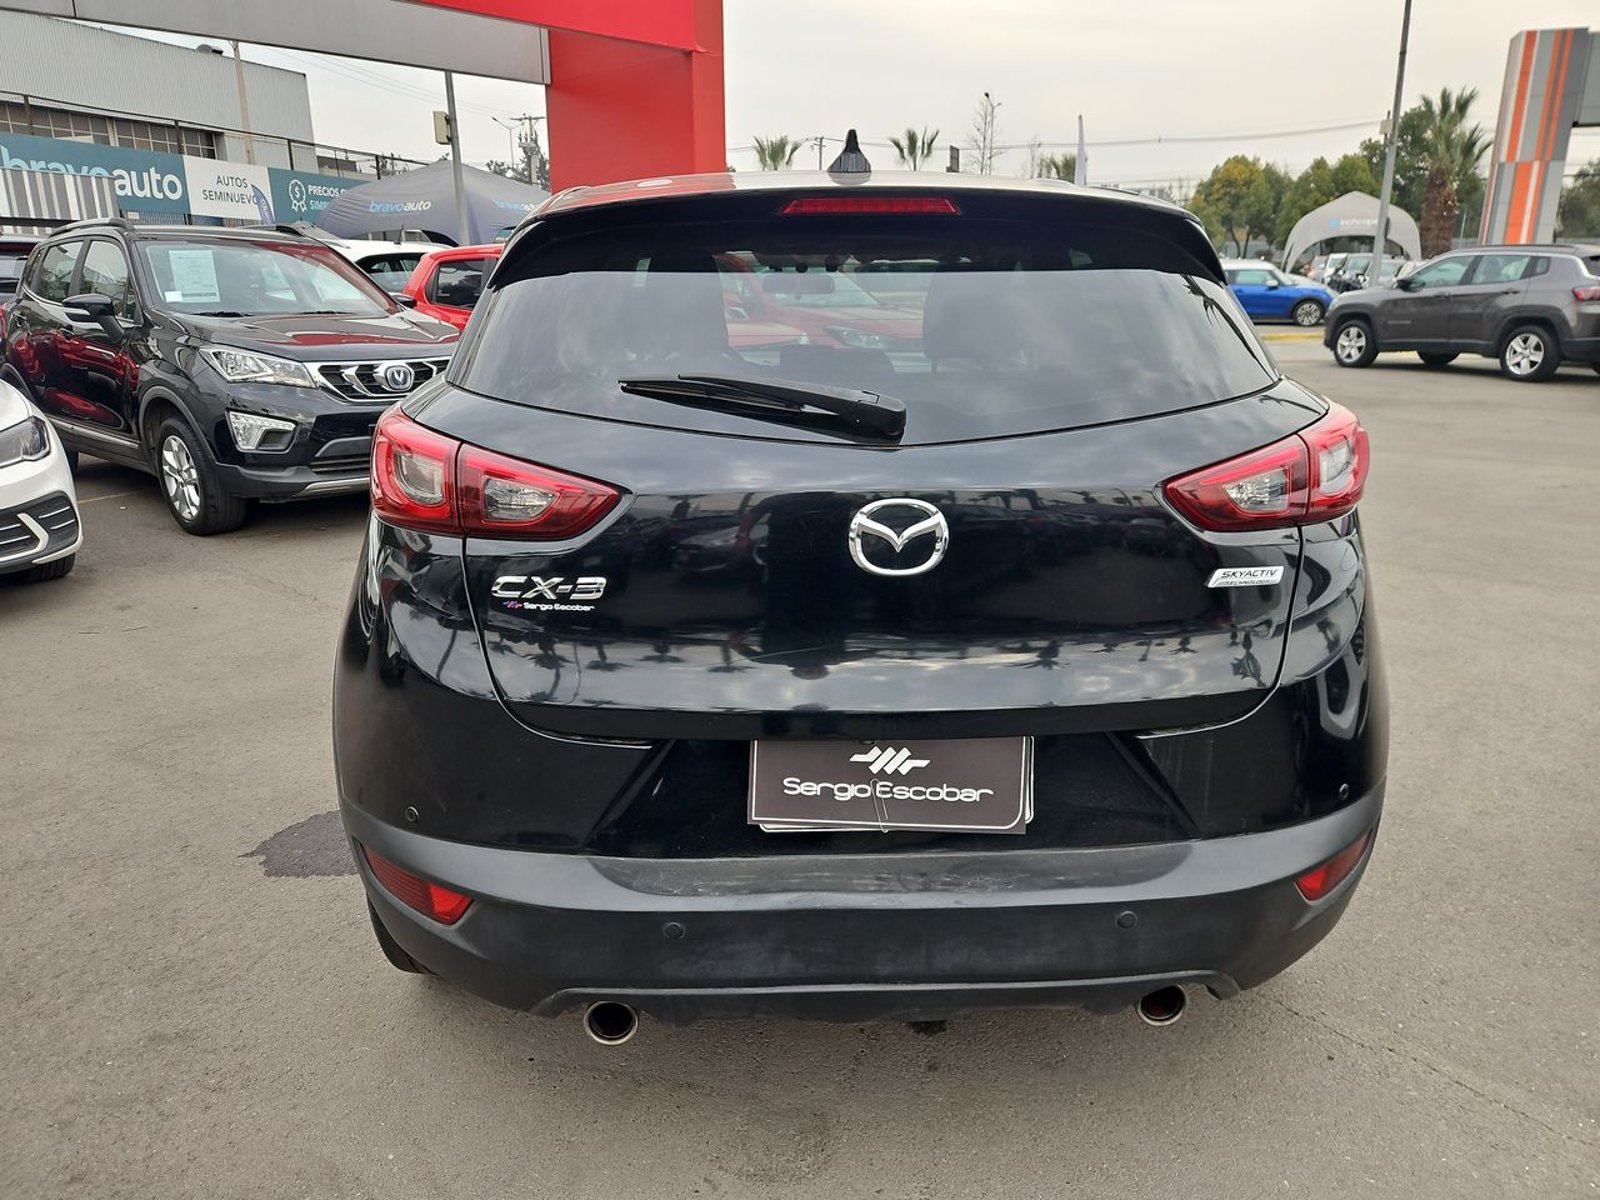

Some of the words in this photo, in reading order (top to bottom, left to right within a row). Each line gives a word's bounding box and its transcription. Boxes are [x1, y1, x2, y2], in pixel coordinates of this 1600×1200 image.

[216, 175, 248, 188] AUTOS
[307, 184, 340, 198] PRECIOS
[368, 200, 432, 213] bravoauto
[1220, 569, 1278, 579] SKYACTIV
[491, 575, 607, 600] CX-3
[554, 603, 595, 611] Escobar
[783, 777, 871, 801] Sergio
[875, 781, 994, 802] Escobar
